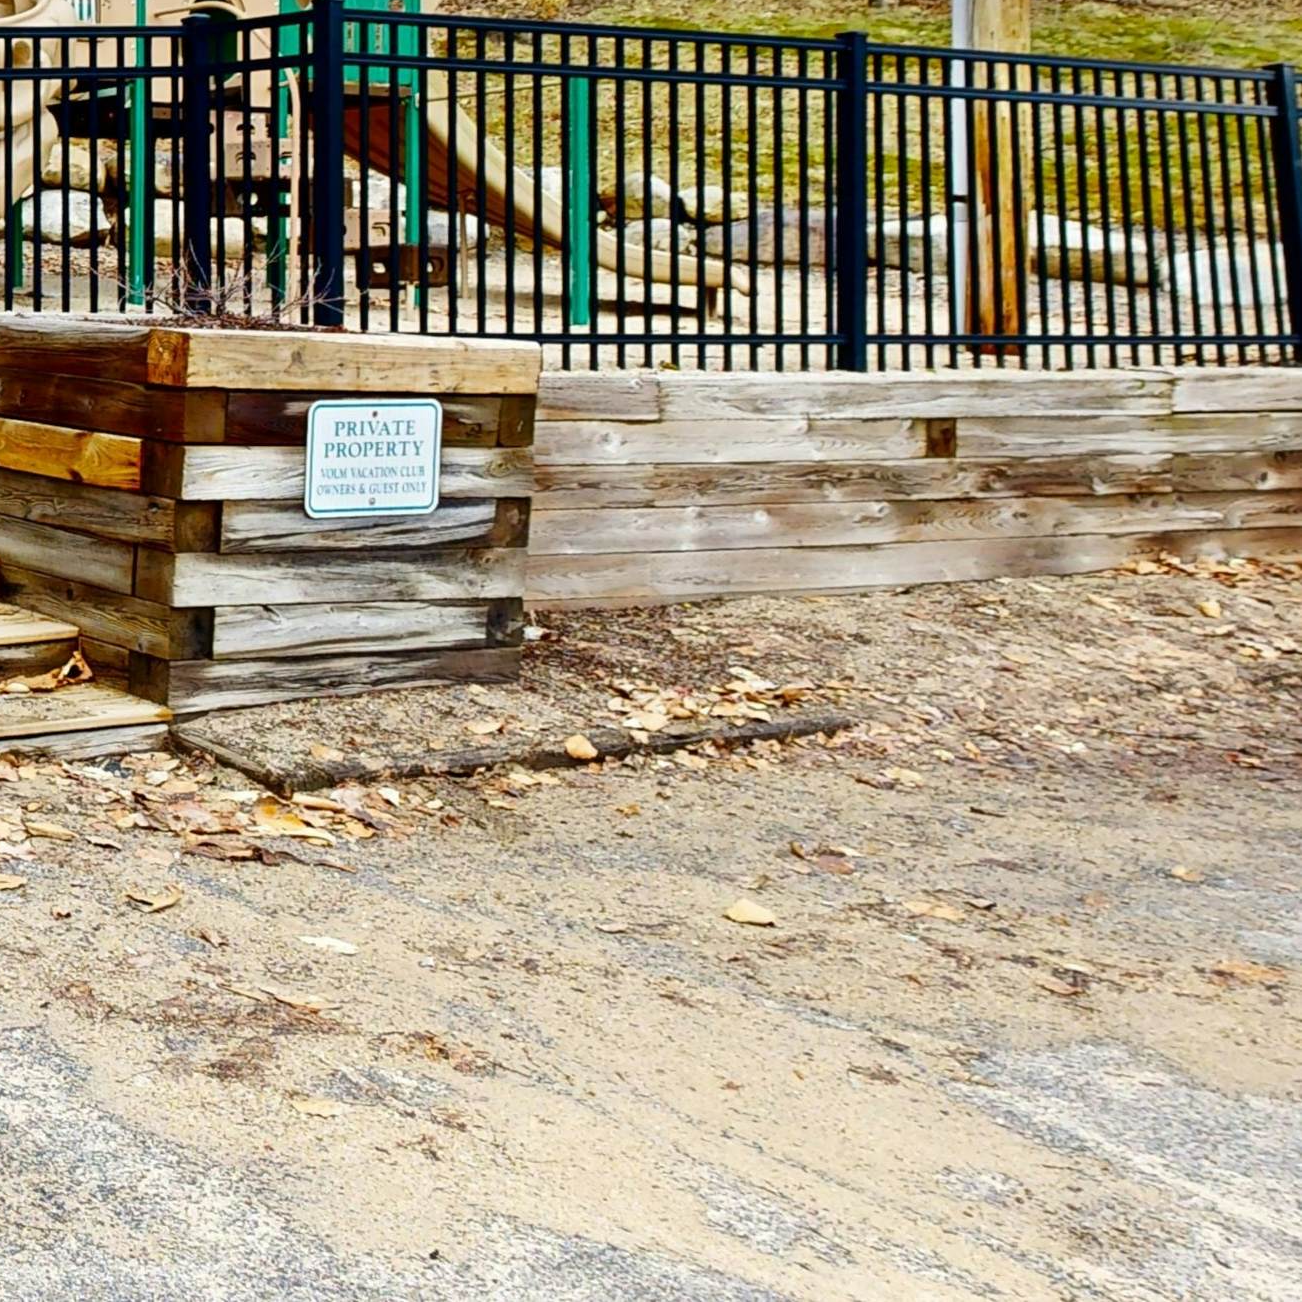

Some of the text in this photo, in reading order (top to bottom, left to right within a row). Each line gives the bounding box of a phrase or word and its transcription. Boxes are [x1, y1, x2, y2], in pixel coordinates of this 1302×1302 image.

[334, 420, 416, 437] PRIVATE
[324, 441, 424, 458] PROPERTY
[350, 466, 398, 479] VACATION
[400, 465, 426, 478] CLUB
[316, 481, 427, 496] OWNERS & GUEST ONLY
